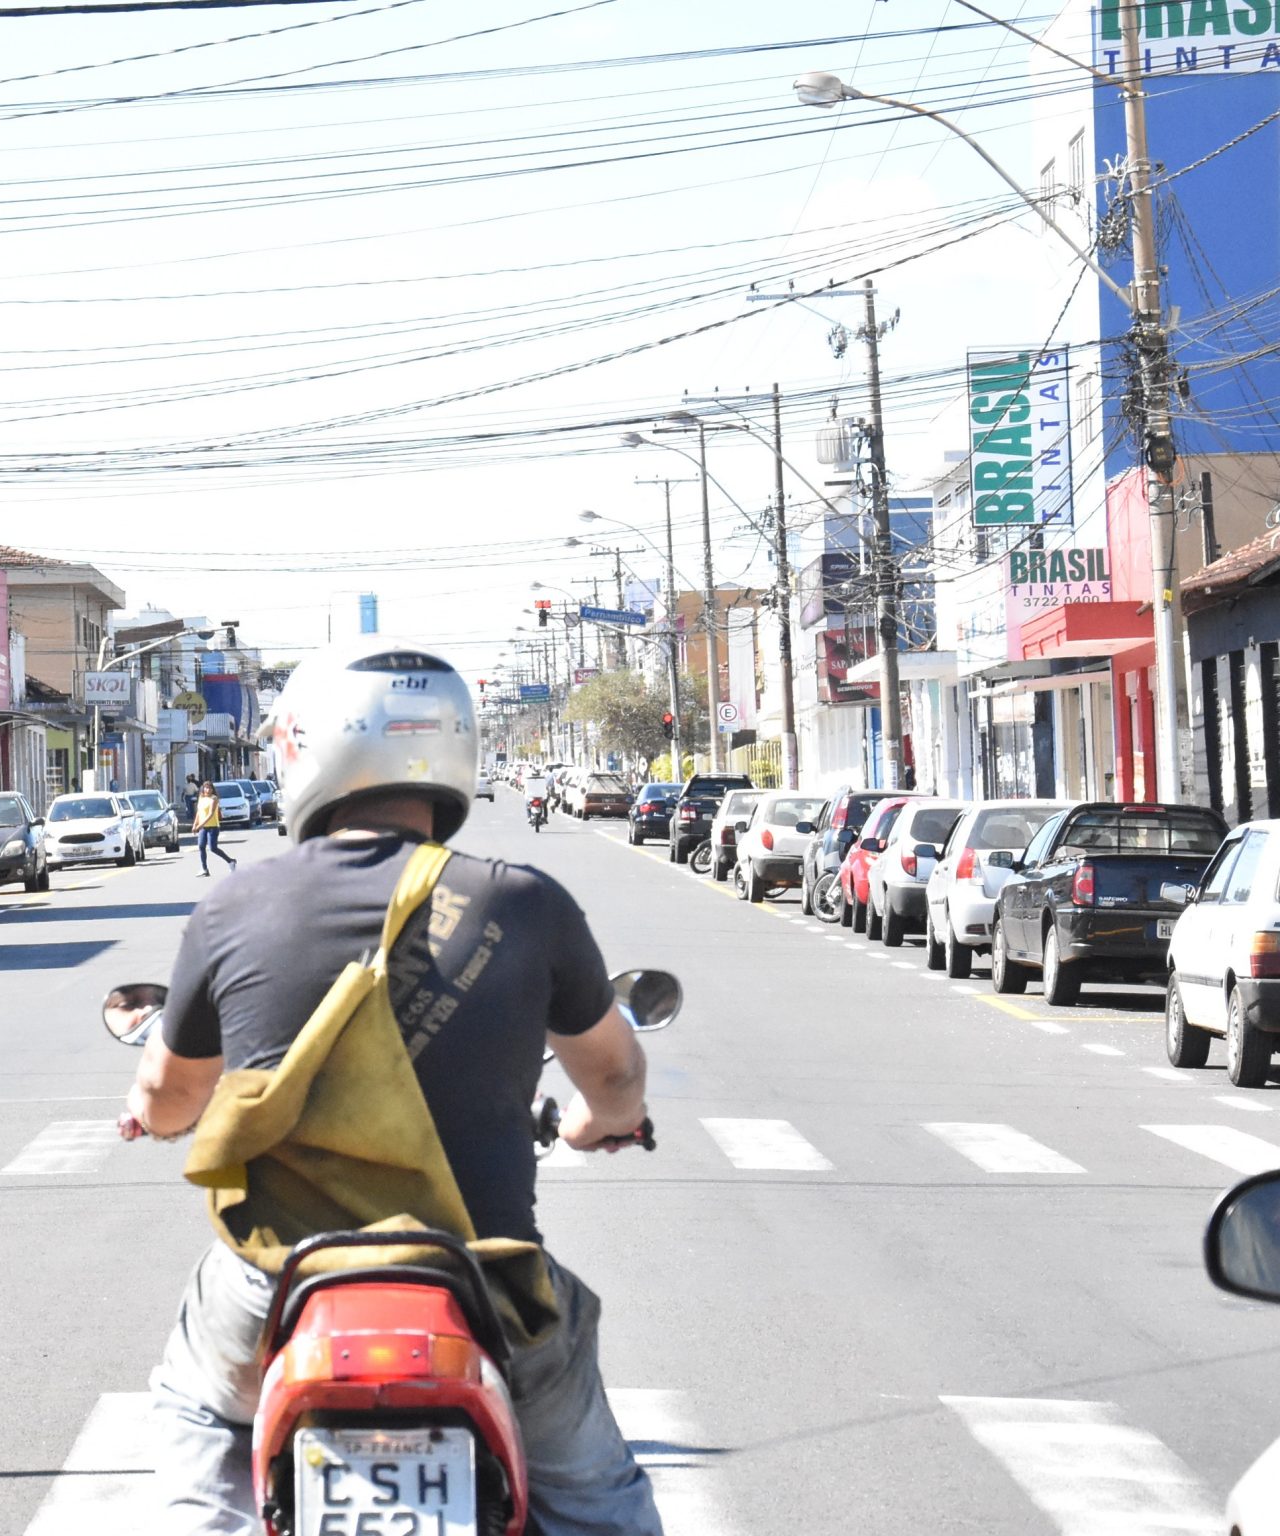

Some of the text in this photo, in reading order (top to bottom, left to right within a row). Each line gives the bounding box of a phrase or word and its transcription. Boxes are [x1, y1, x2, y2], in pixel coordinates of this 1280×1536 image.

[970, 353, 1035, 524] BRASIL
[1039, 353, 1062, 522] TINTAS
[1010, 548, 1110, 584] BRASIL
[1011, 582, 1110, 597] TINTAS
[1023, 597, 1059, 607] 3722
[86, 677, 128, 693] SKOL
[724, 708, 733, 718] E
[323, 1463, 448, 1507] CSH
